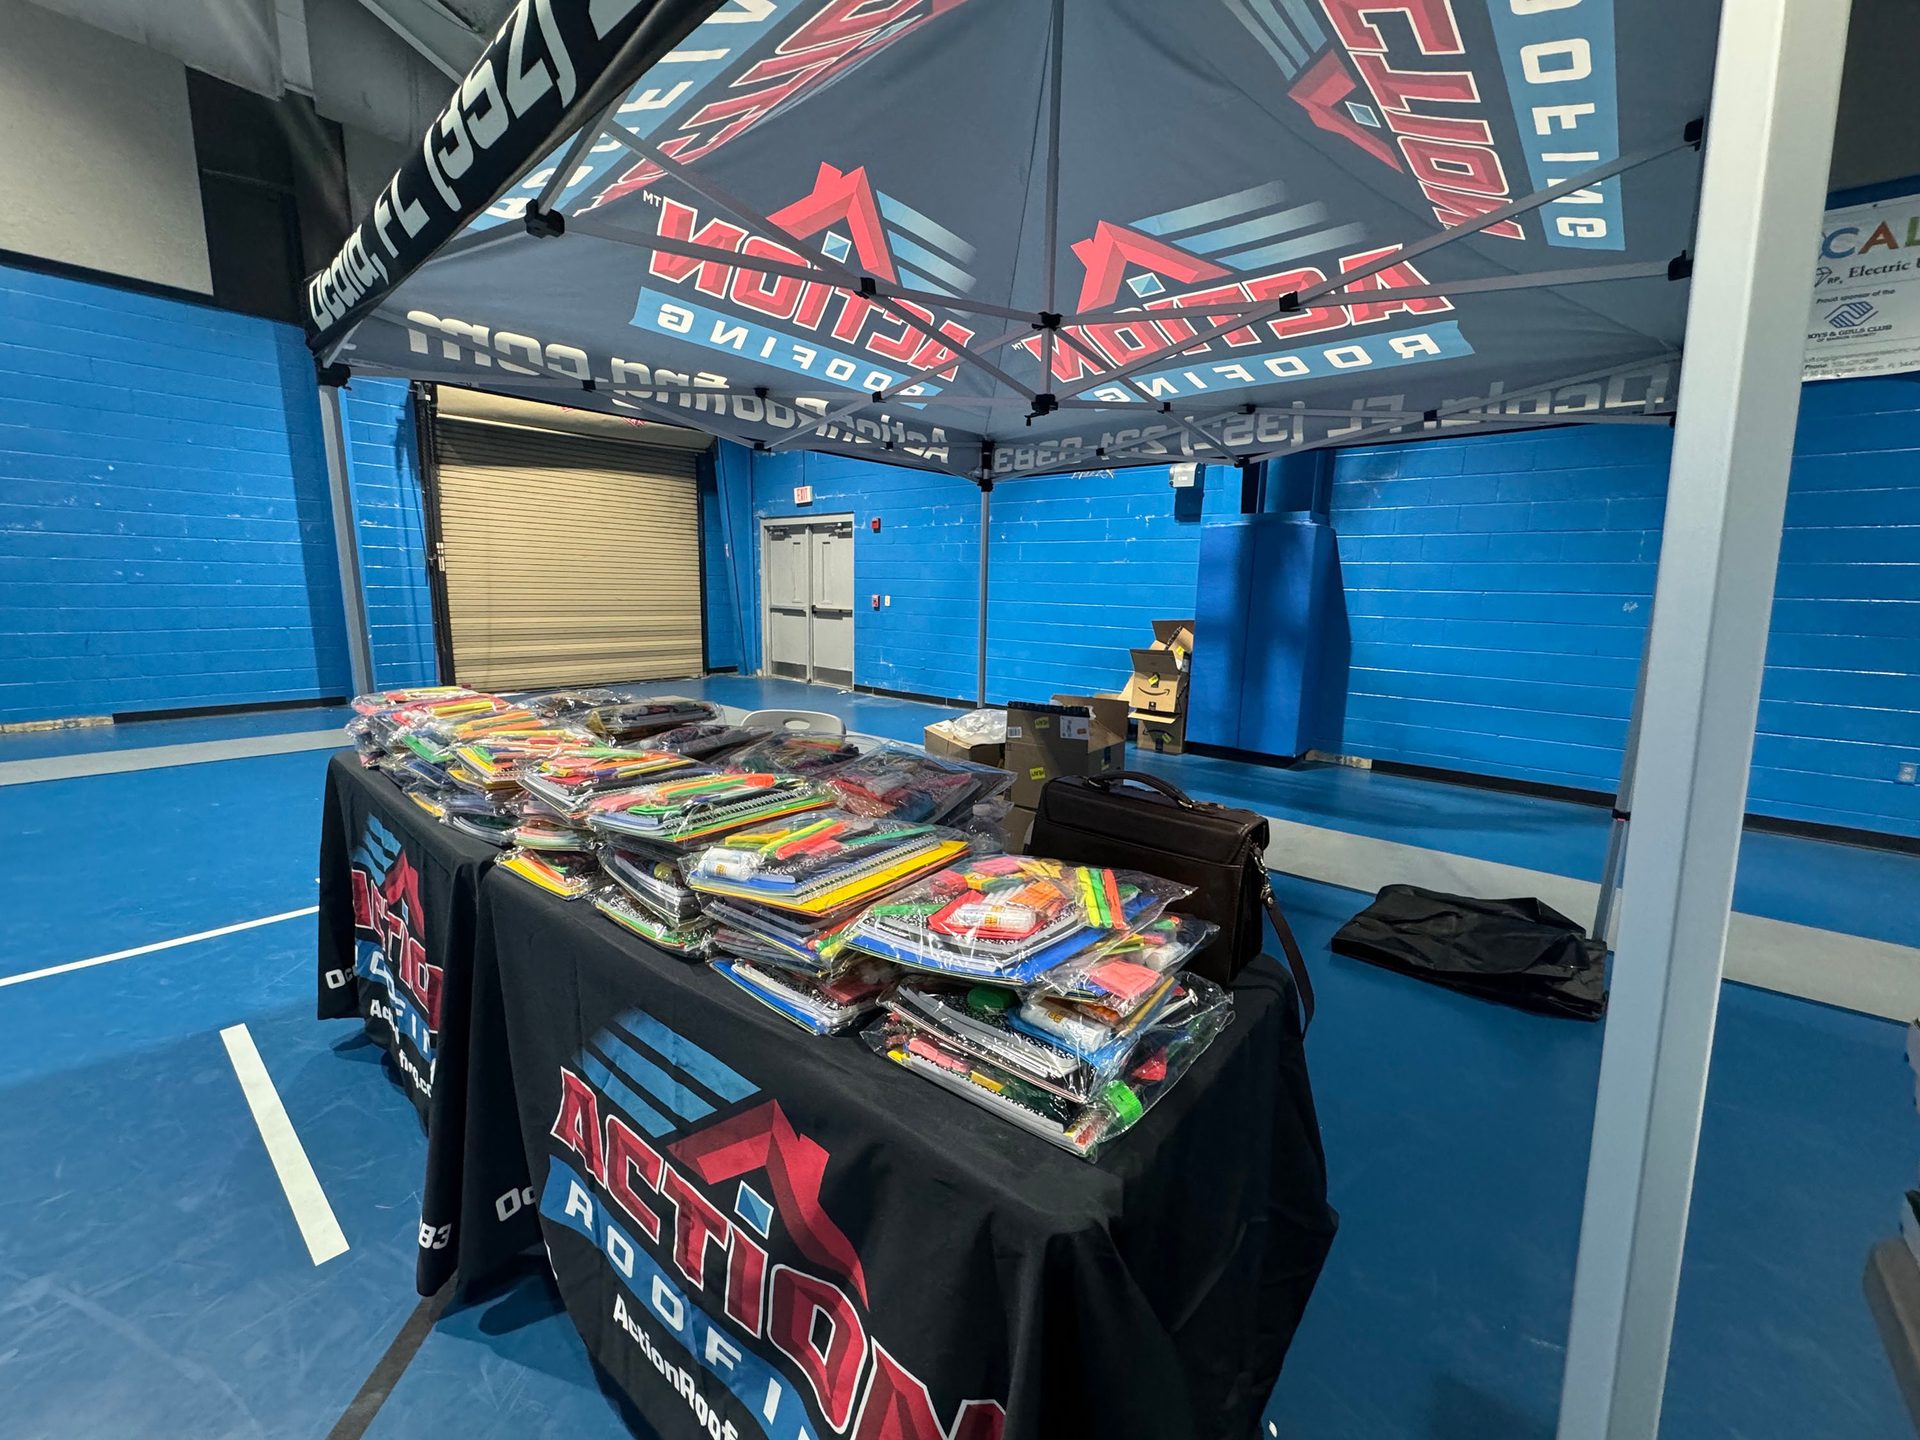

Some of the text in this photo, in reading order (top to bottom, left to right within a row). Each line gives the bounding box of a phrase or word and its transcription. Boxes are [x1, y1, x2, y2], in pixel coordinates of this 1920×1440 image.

[309, 0, 577, 332] Ocala, FL (352)
[1849, 261, 1911, 278] Electric
[1872, 290, 1882, 298] of
[1838, 327, 1865, 336] GIRLS
[1867, 324, 1892, 333] CLUB
[564, 1179, 811, 1440] ROOFI
